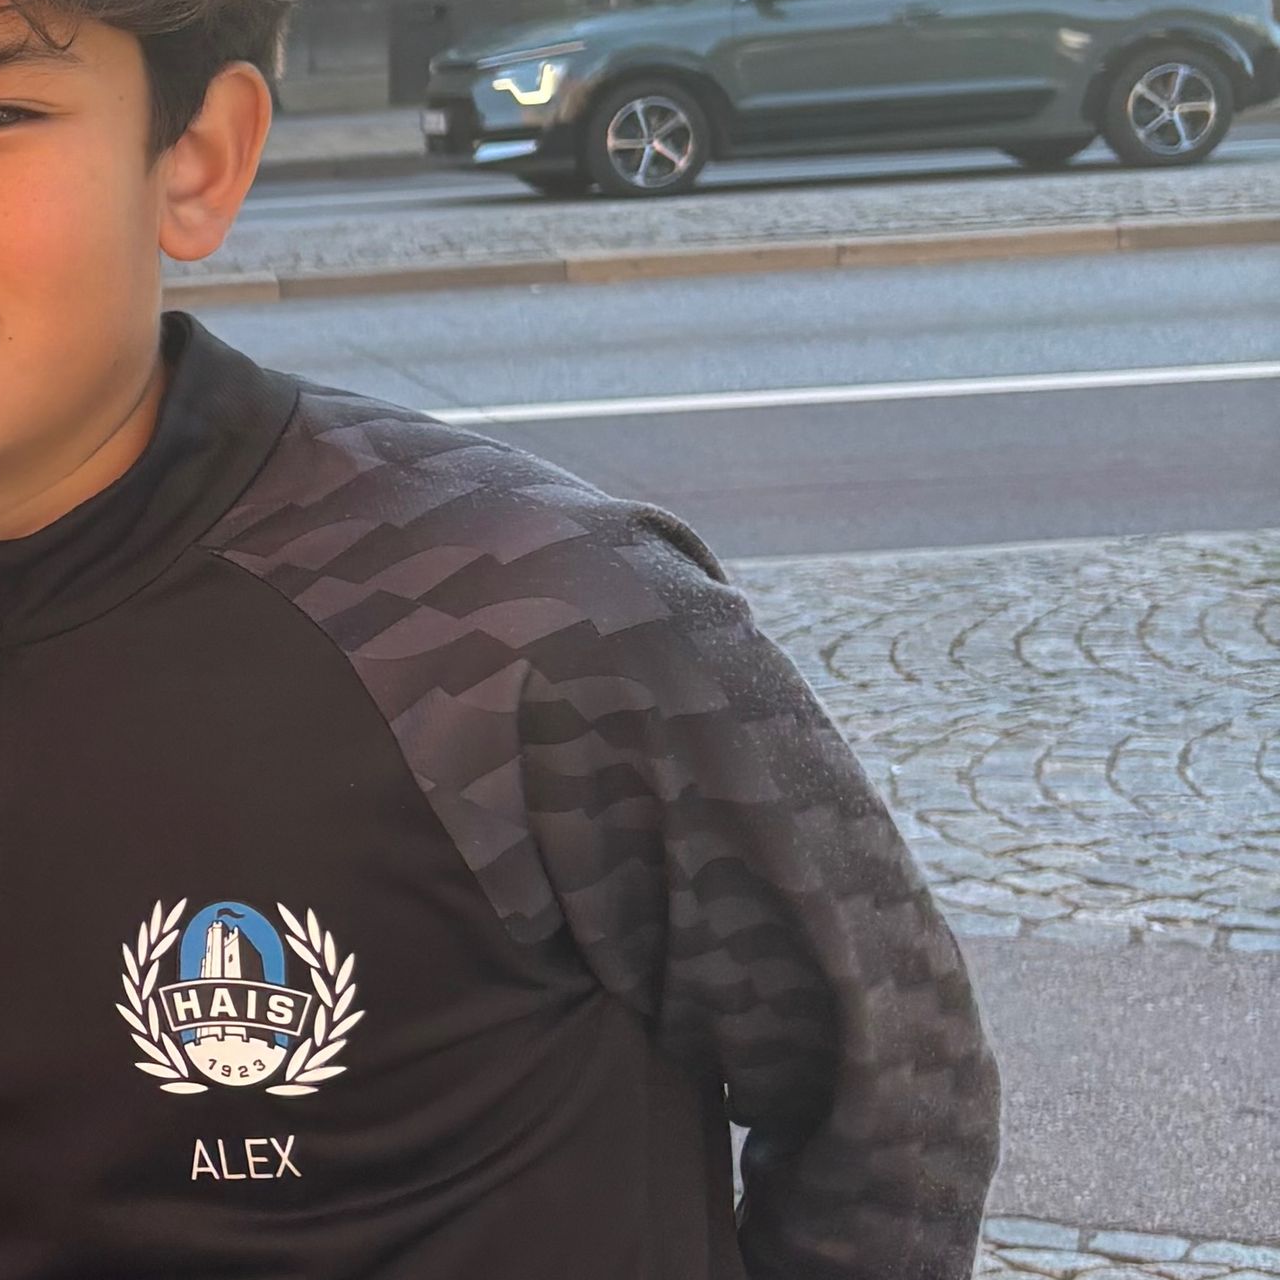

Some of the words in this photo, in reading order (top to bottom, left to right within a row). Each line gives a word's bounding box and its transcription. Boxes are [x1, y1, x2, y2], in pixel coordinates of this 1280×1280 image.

[172, 987, 295, 1025] HAIS
[208, 1058, 267, 1078] 1923
[191, 1135, 302, 1181] ALEX
